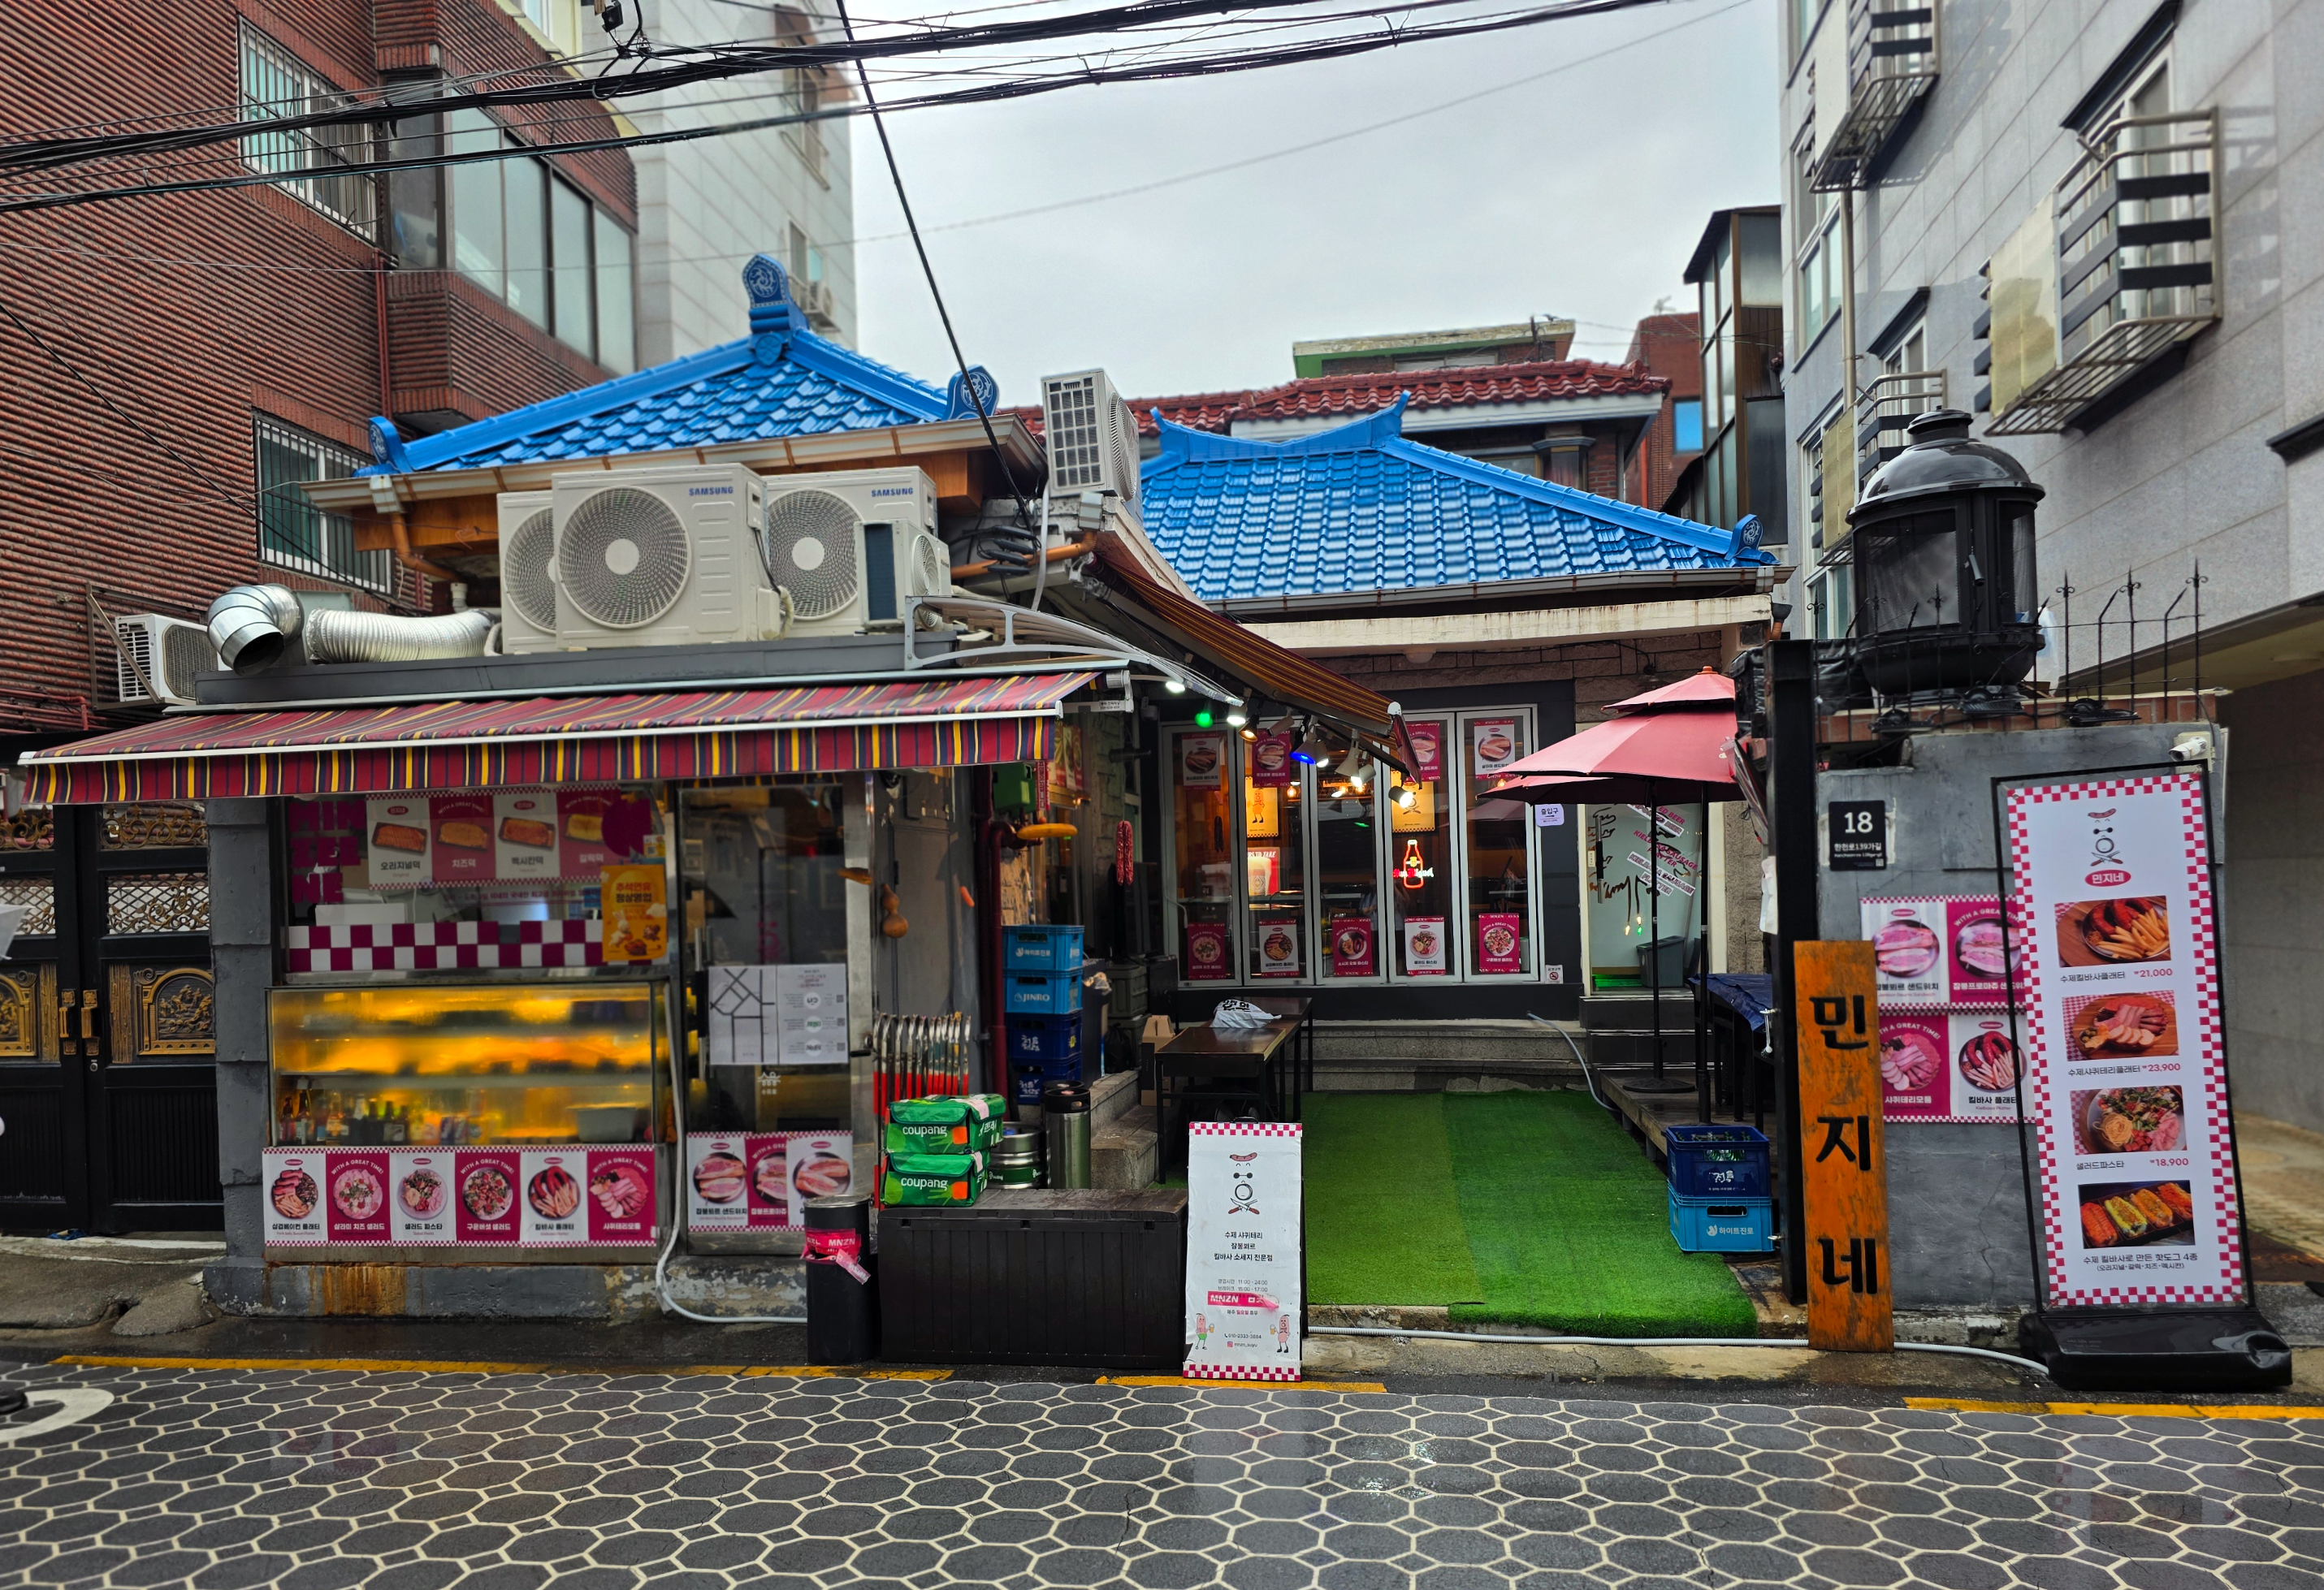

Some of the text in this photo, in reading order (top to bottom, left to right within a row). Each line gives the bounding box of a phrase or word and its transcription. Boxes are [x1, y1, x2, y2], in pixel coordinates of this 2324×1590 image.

[689, 486, 734, 496] SAMSUNG
[871, 487, 914, 497] SAMSUNG
[438, 806, 450, 814] WITH
[472, 804, 485, 813] TIME!
[288, 800, 366, 832] MIN
[1668, 812, 1686, 824] BEER
[1844, 811, 1873, 833] 18
[290, 836, 361, 868] ZEE
[1634, 830, 1698, 870] KIELBSA SAUSAGE
[2092, 872, 2124, 884] 민지네
[292, 872, 344, 904] NE
[616, 893, 652, 903] 정상영업
[1954, 914, 1971, 927] WITH
[2060, 971, 2126, 983] 수제킬바사플래터
[1907, 983, 1939, 991] 샌드위치
[1024, 994, 1050, 1002] JINRO
[1923, 1026, 1941, 1040] TIME!
[2068, 1065, 2140, 1076] 수제샤퀴테리플래터
[902, 1126, 947, 1138] coupang
[1809, 995, 1878, 1294] 민지네
[331, 1164, 344, 1175] WITH
[370, 1162, 384, 1174] TIME!
[461, 1163, 474, 1174] WITH
[500, 1162, 515, 1174] TIME!
[2076, 1160, 2124, 1170] 샐러드파스타
[901, 1177, 948, 1190] coupang
[1719, 1227, 1754, 1235] 하이트진로
[829, 1238, 855, 1247] MNZN
[1234, 1253, 1253, 1261] 소세지
[1254, 1254, 1273, 1262] 전문점
[2084, 1253, 2198, 1264] 수제 킬바사로 만든 핫도그 4종
[1210, 1294, 1239, 1303] MNZN
